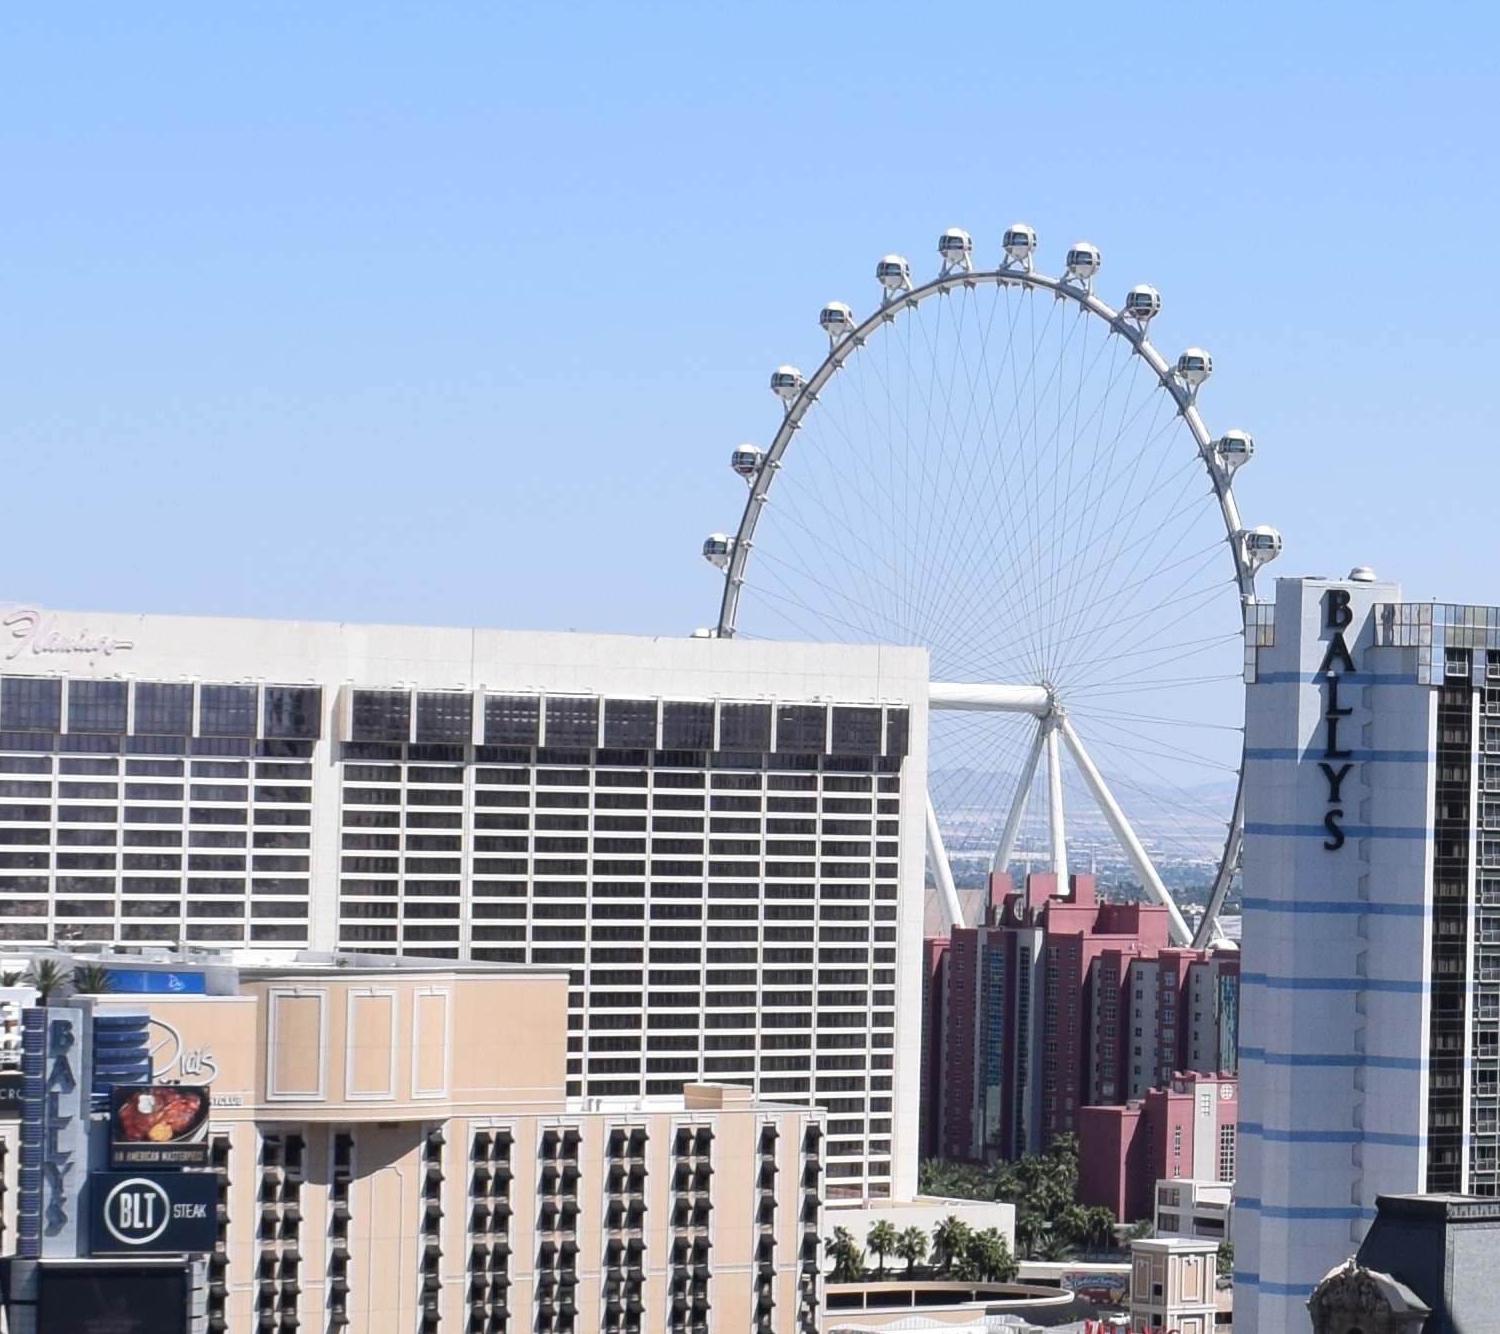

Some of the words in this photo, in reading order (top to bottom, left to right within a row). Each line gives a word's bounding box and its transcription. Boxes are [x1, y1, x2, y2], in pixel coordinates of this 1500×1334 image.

[3, 610, 134, 667] Flamingo
[126, 1150, 160, 1162] AMERICAN
[161, 1150, 204, 1162] MASTERPIECE
[120, 1192, 157, 1228] BLT
[173, 1203, 207, 1219] STEAK
